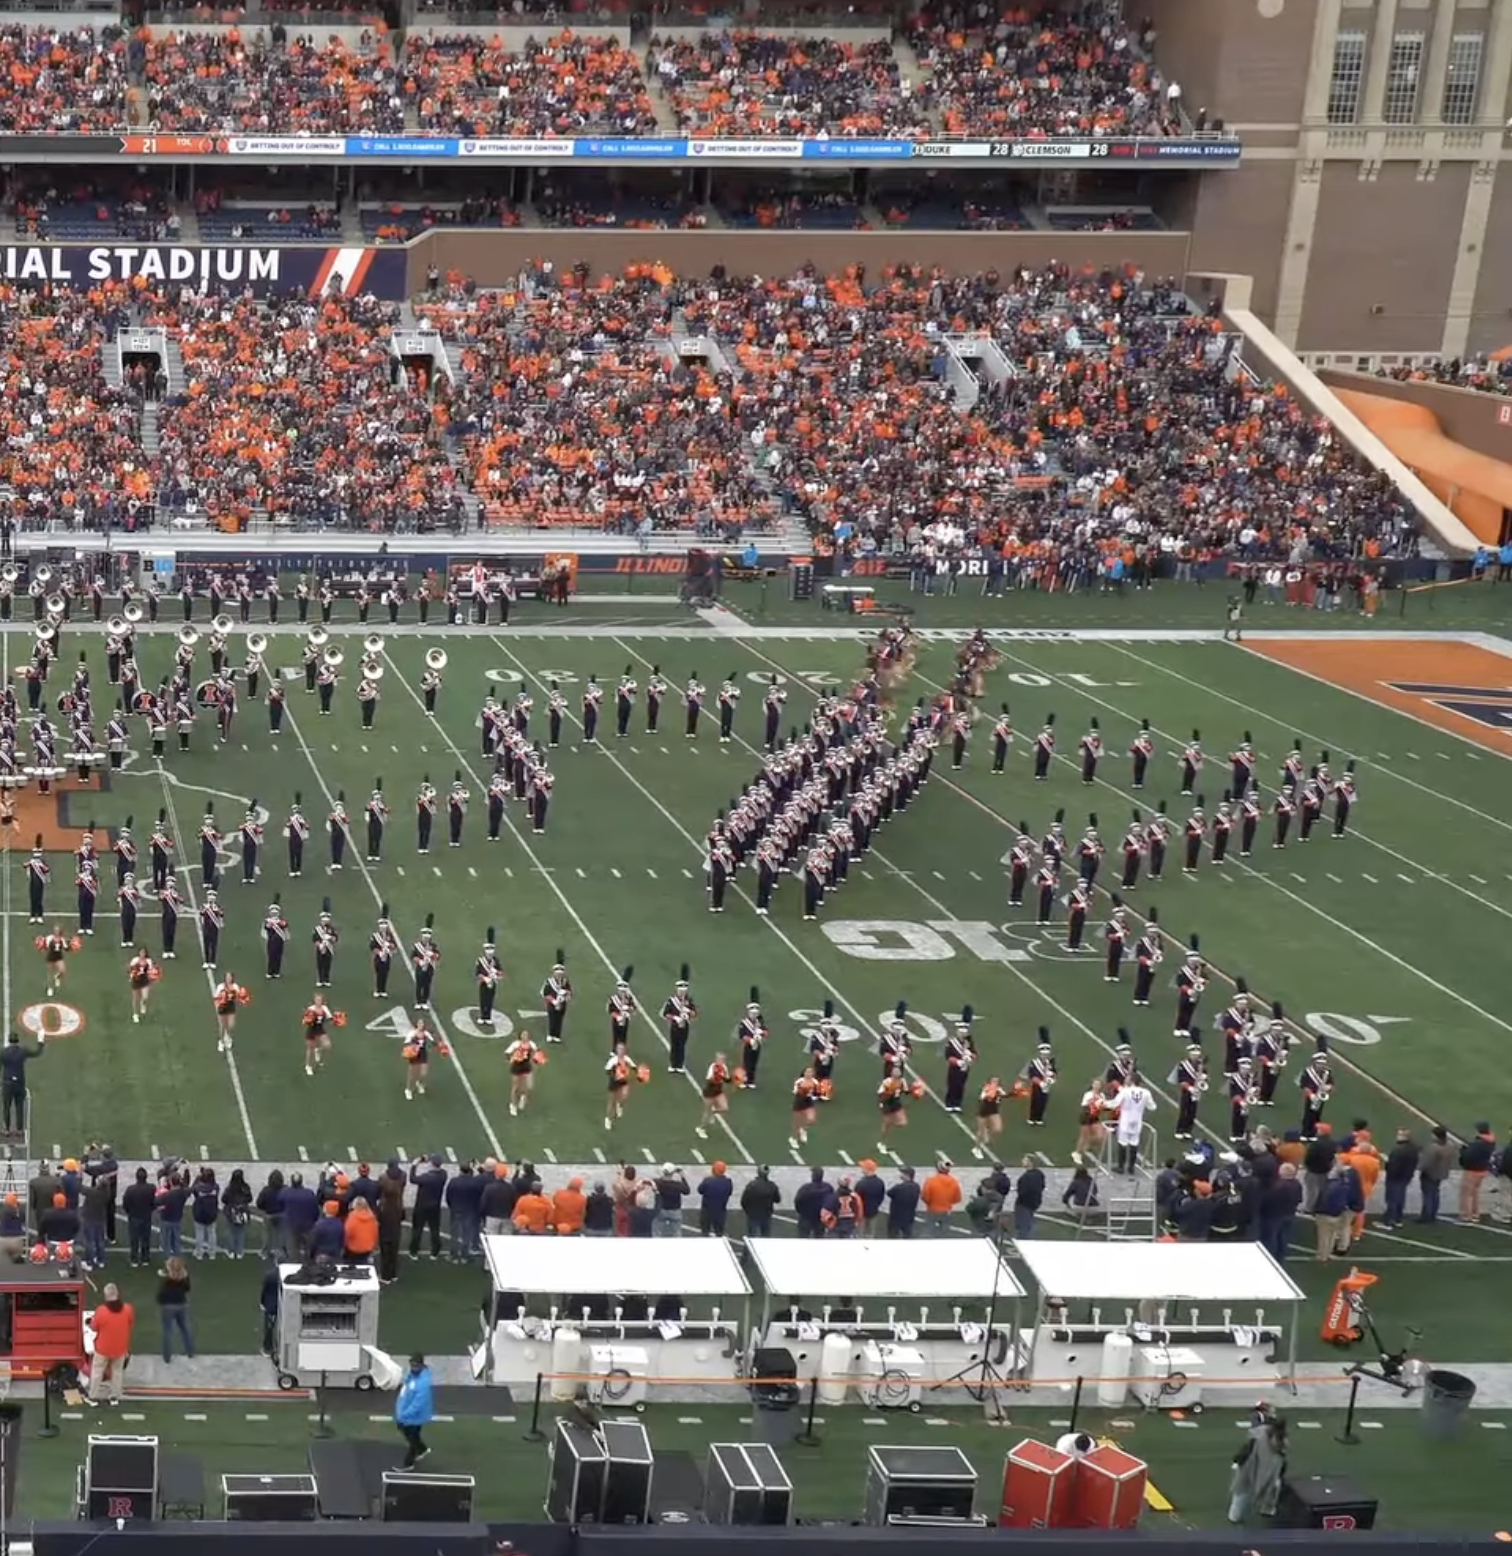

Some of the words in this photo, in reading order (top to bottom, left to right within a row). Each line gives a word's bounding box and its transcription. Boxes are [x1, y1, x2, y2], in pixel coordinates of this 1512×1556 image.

[143, 138, 157, 153] 21
[927, 146, 951, 154] DUKE
[992, 144, 1009, 155] 28
[1026, 146, 1071, 155] CLEMSON
[1092, 144, 1108, 156] 28
[88, 248, 280, 280] STADIUM
[365, 1006, 515, 1038] 40
[108, 1496, 133, 1518] R
